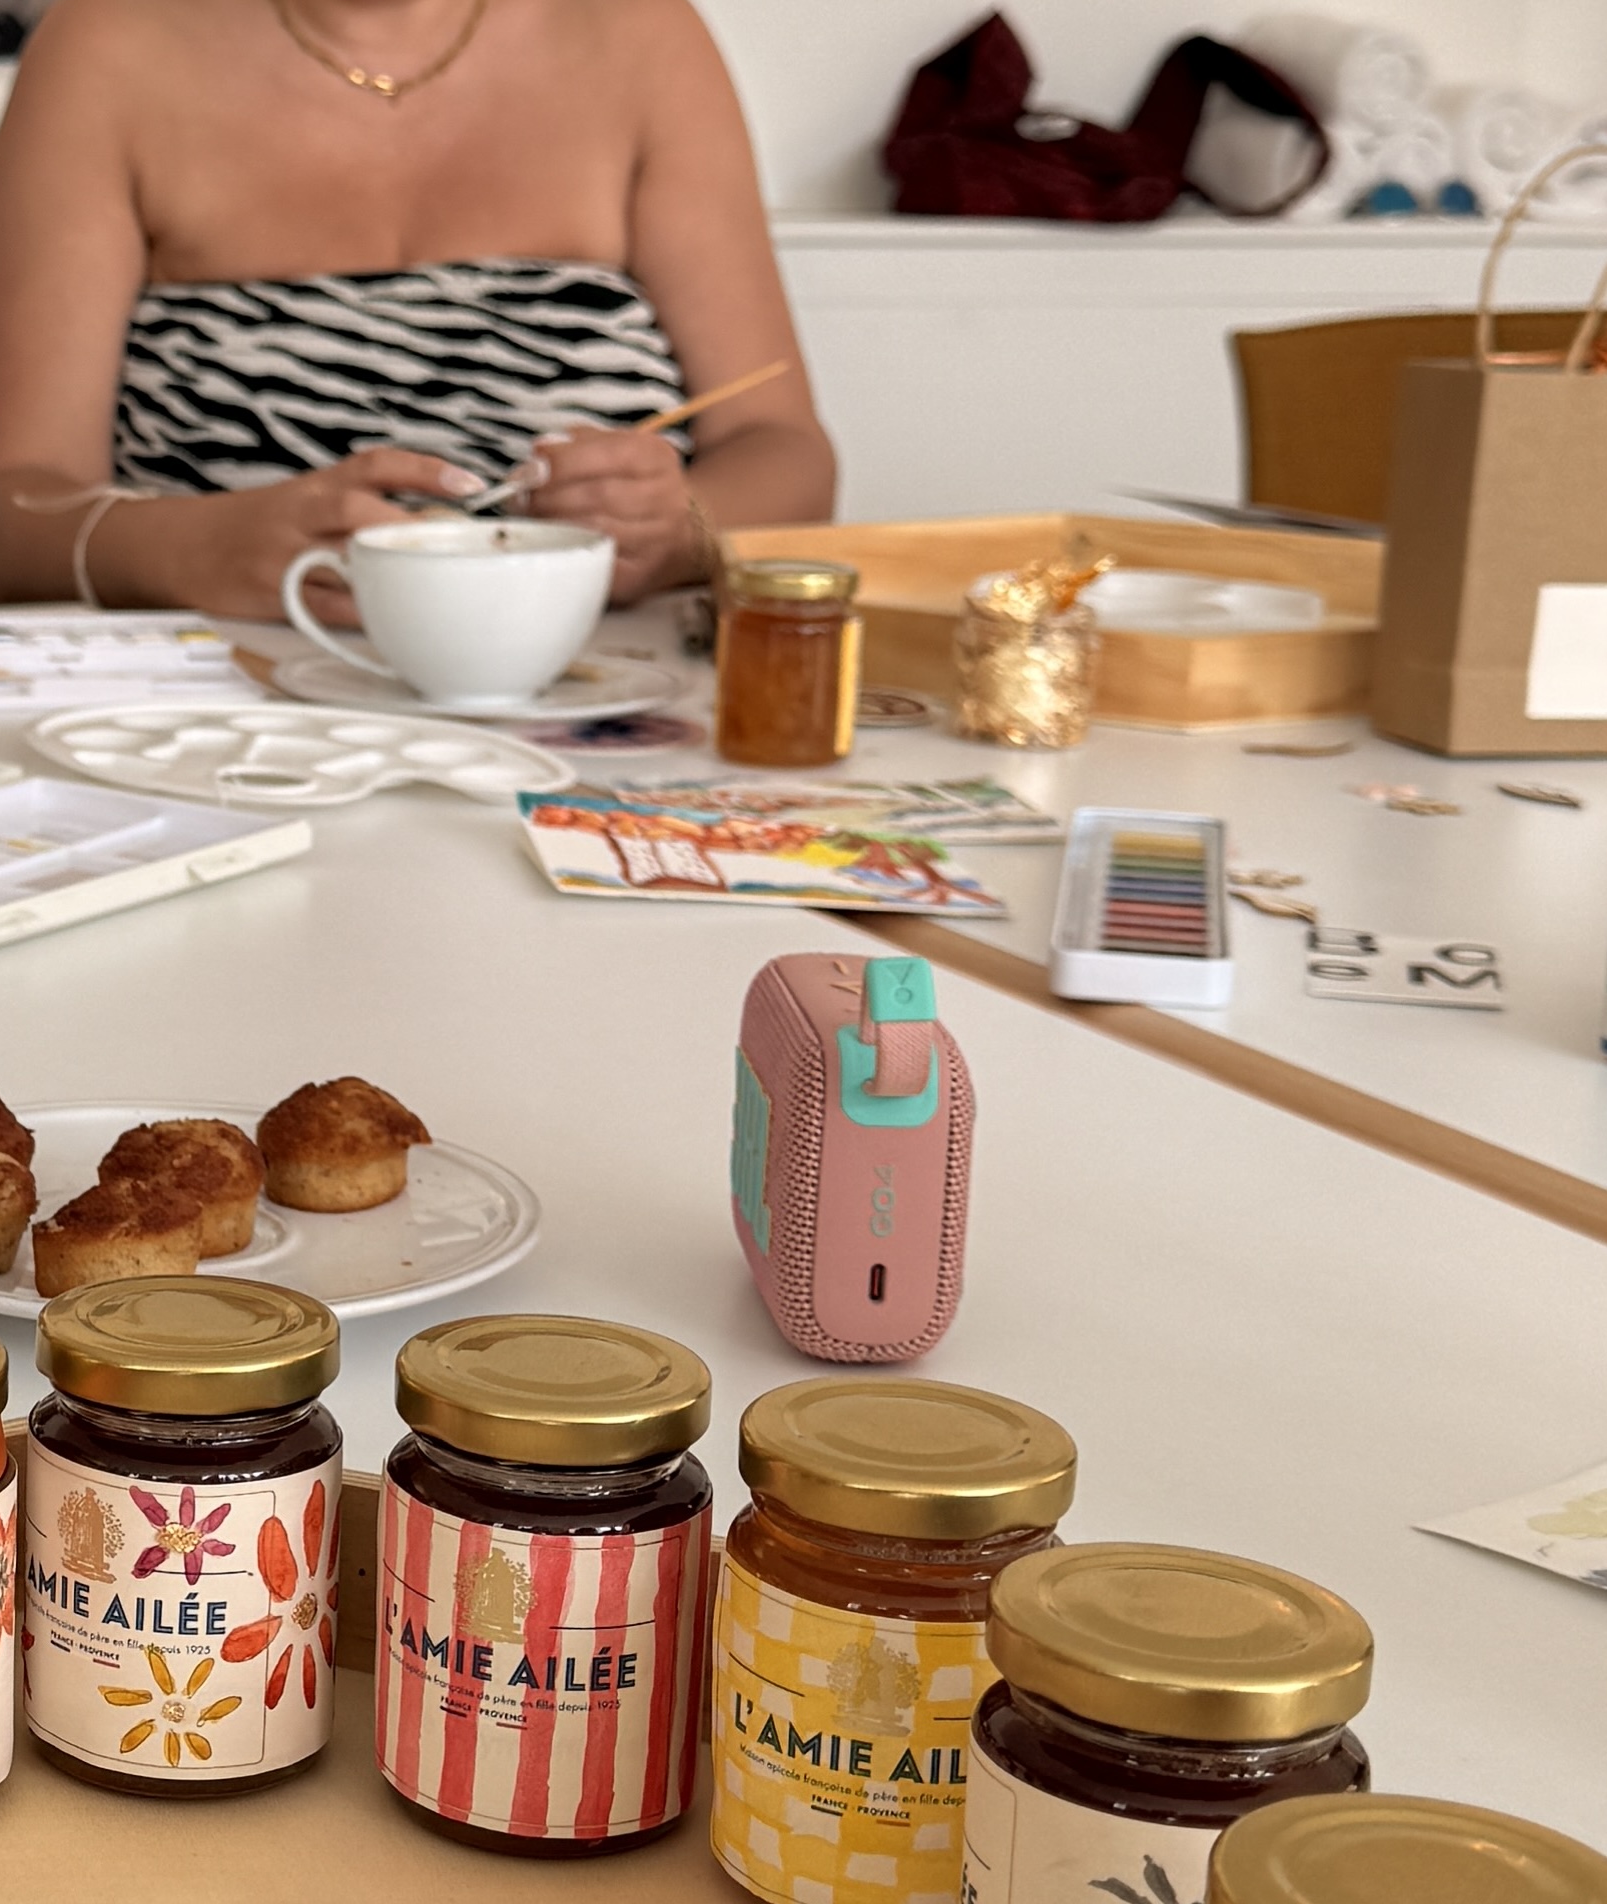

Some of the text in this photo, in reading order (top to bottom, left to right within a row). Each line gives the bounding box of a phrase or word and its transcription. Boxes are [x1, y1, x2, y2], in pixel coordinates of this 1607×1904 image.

[27, 1552, 228, 1636] AMIE AILÉE
[90, 1630, 110, 1645] père
[112, 1638, 125, 1648] en
[185, 1644, 212, 1655] 1925
[384, 1596, 639, 1692] L'AMIE AILÉE
[479, 1707, 528, 1724] PROVENCE
[734, 1691, 968, 1786] L'AMIE AIL
[767, 1761, 802, 1782] apicole
[804, 1772, 853, 1796] française
[855, 1786, 870, 1799] de
[872, 1790, 899, 1804] père
[902, 1795, 917, 1805] en
[919, 1793, 940, 1806] fille
[811, 1794, 912, 1820] FRANCE PROVENCE
